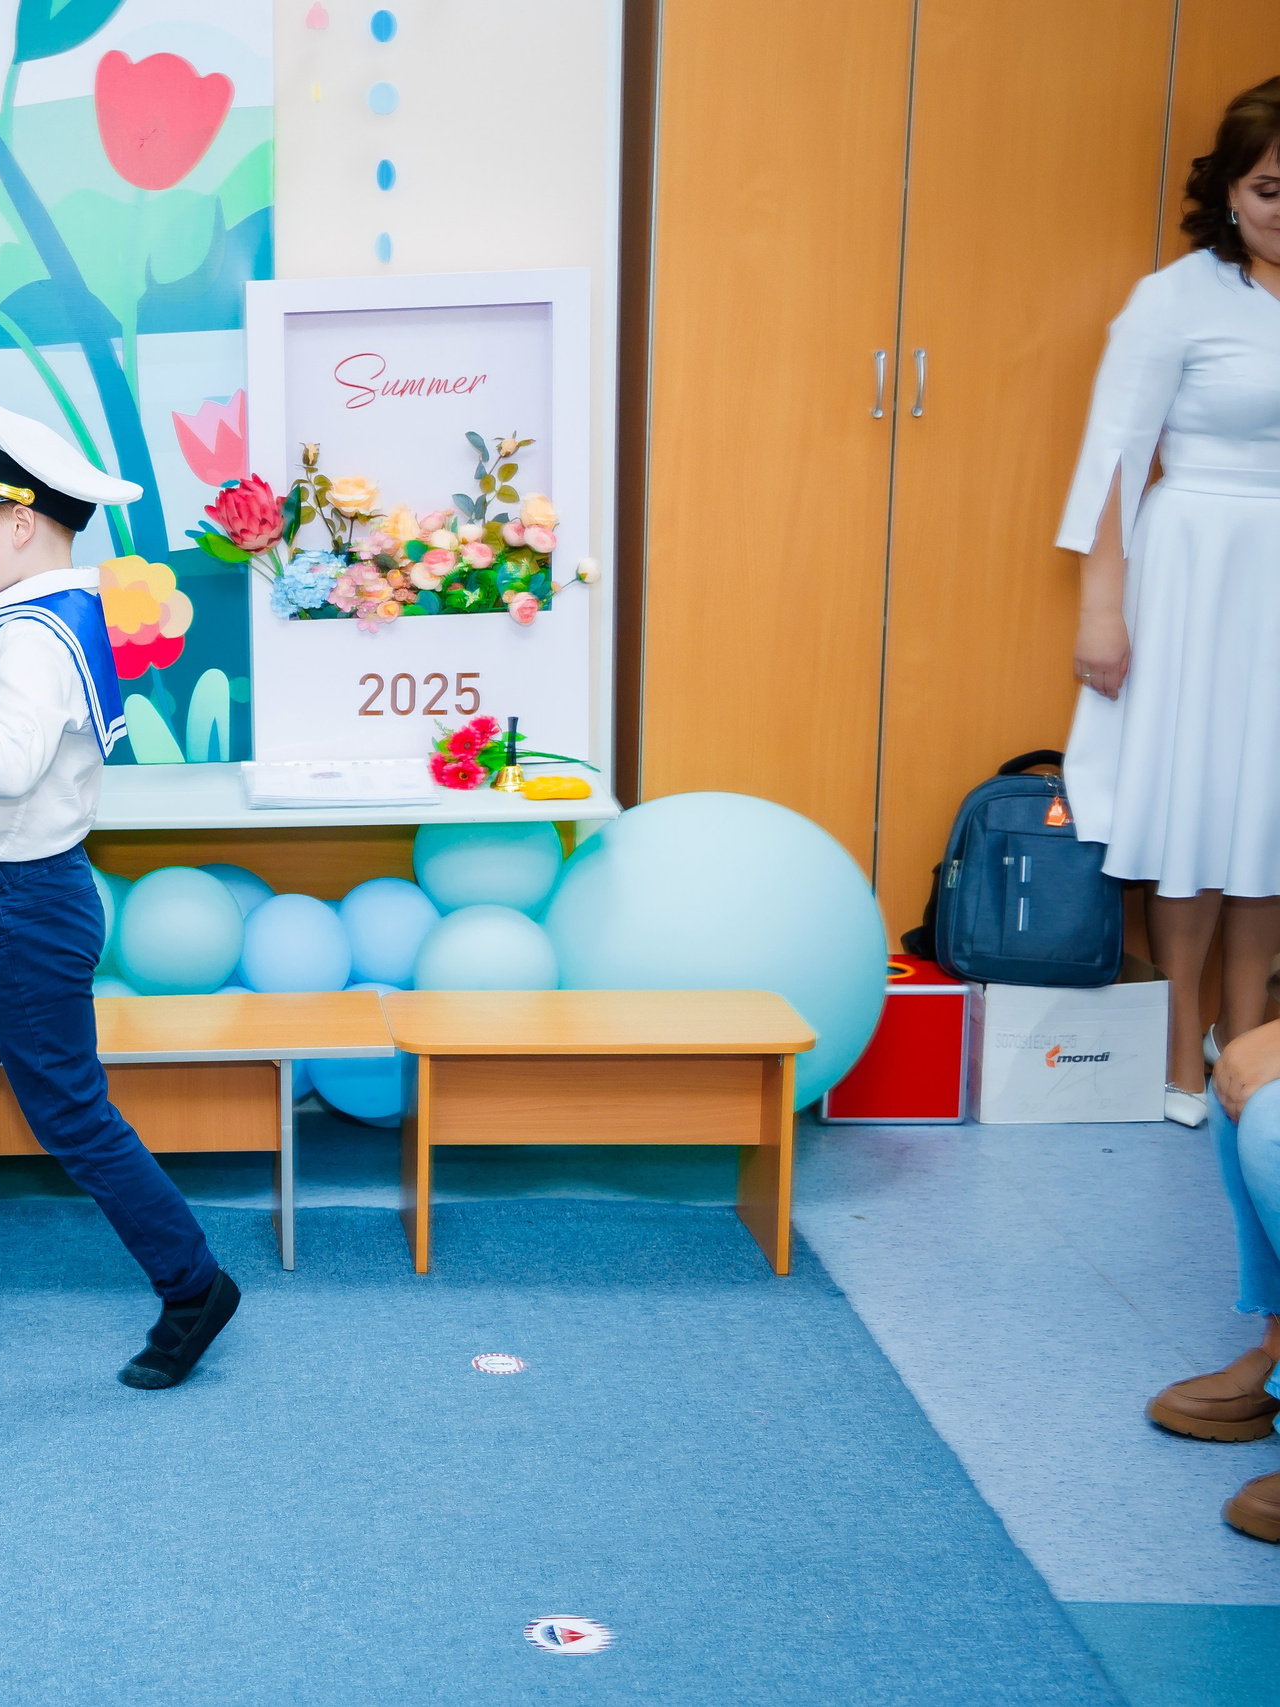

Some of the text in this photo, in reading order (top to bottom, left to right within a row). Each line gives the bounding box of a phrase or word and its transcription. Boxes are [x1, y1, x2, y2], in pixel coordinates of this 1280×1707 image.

[333, 352, 488, 410] Summer
[357, 672, 482, 717] 2025
[1056, 1051, 1110, 1063] mondi
